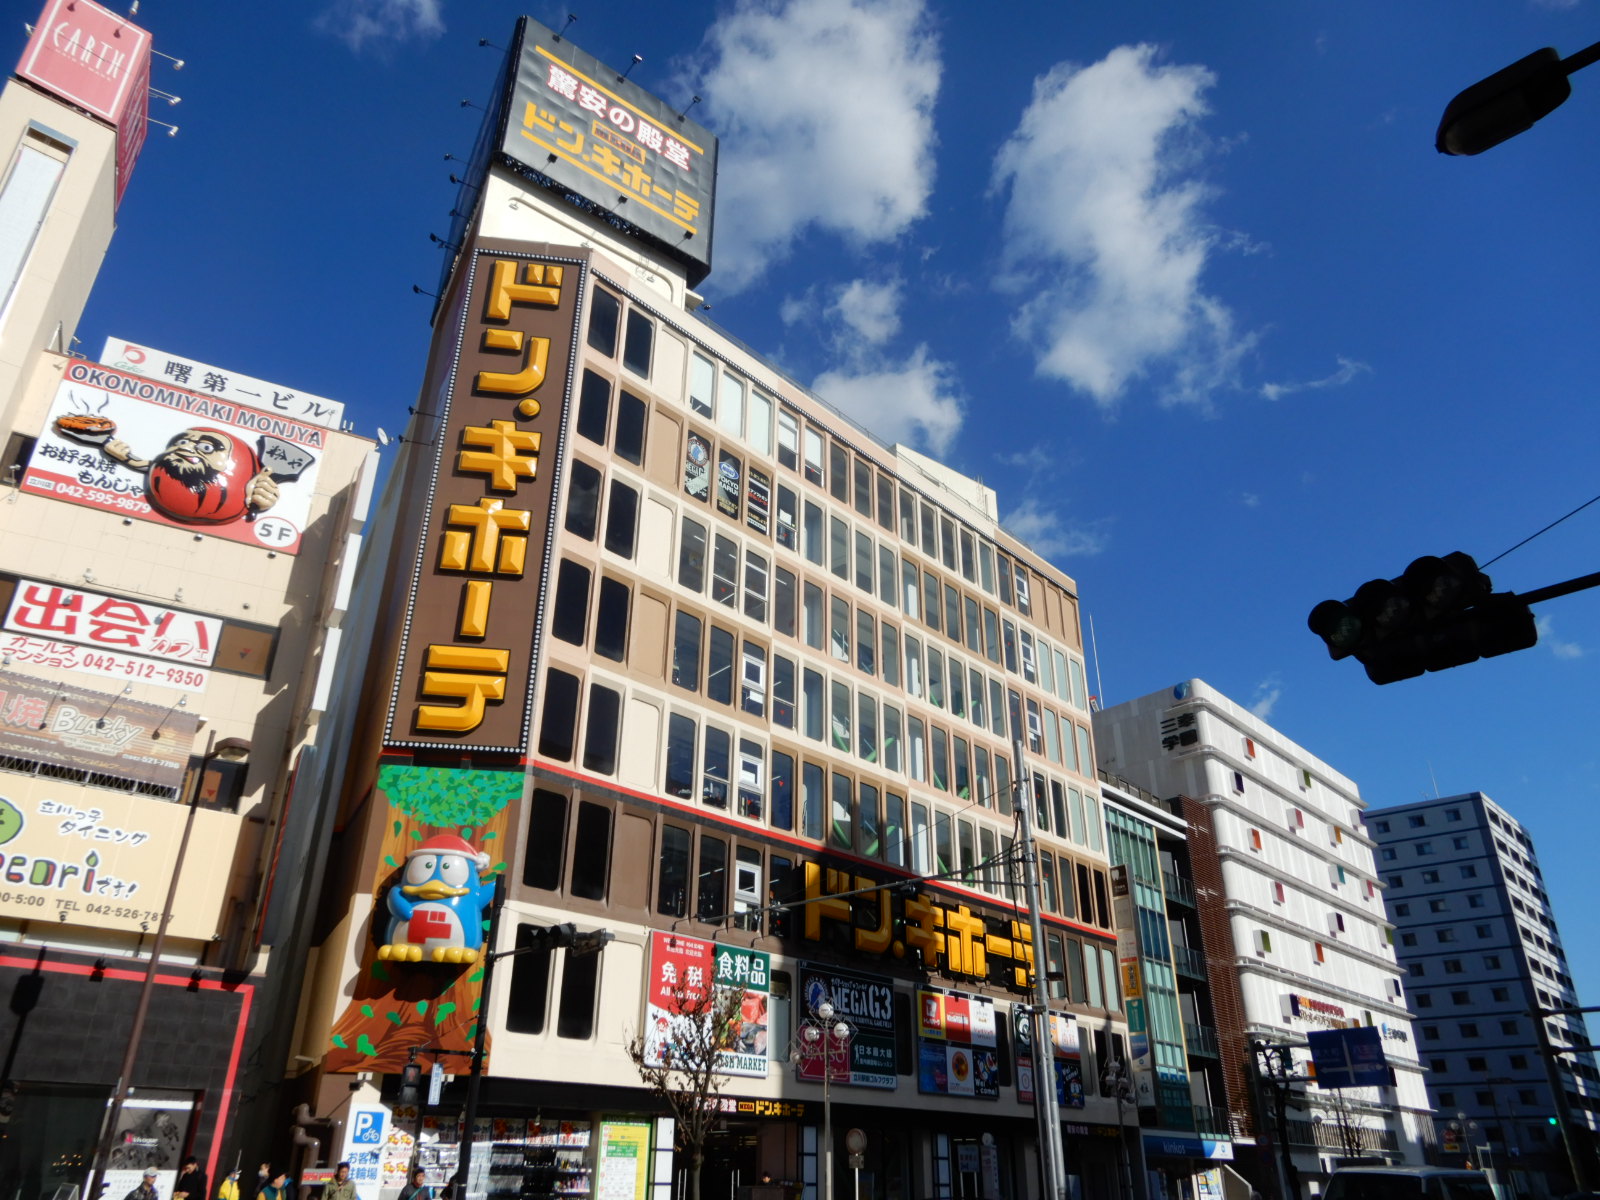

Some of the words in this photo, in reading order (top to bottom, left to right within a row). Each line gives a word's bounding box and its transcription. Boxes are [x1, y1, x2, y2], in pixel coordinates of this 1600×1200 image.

[53, 22, 125, 78] EARTH
[547, 64, 691, 171] 驚安の殿堂
[165, 361, 330, 417] 曙第一ビル
[70, 366, 232, 422] OKONOMIYAKI
[237, 411, 321, 446] MONJYA
[39, 443, 117, 475] お好み焼
[78, 469, 144, 497] もんじゃ
[56, 483, 151, 513] 042-595-9879
[259, 523, 292, 541] 5F
[0, 647, 79, 669] マンション
[10, 636, 79, 657] ガールズ
[149, 636, 209, 663] カフェ
[83, 654, 204, 687] 042-512-9350
[0, 690, 48, 730] 焼
[40, 802, 101, 822] 立川っ子
[60, 821, 147, 845] ダイニング
[0, 892, 45, 907] 0-5:00
[56, 898, 80, 912] TEL
[86, 903, 174, 924] 042-526-787
[661, 961, 703, 988] 免税
[717, 951, 766, 986] 食料品
[660, 986, 671, 997] All
[736, 1055, 767, 1072] MARKET
[355, 1113, 373, 1136] P
[348, 1152, 380, 1165] お客様
